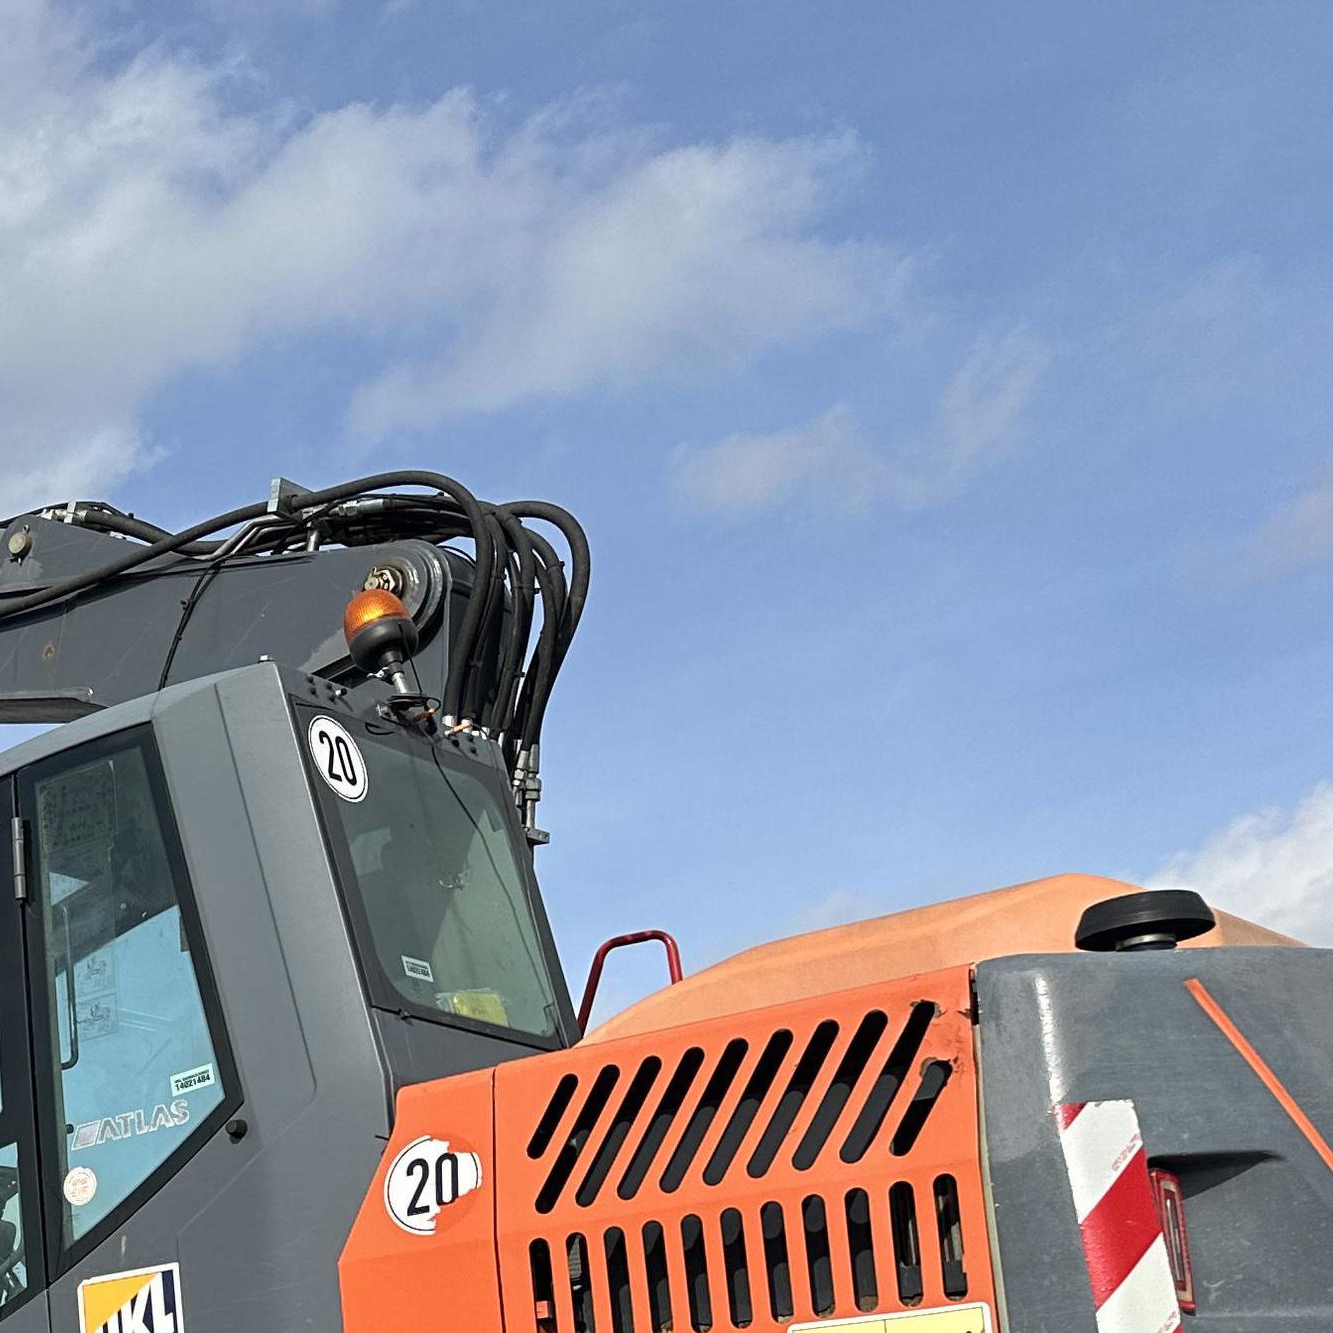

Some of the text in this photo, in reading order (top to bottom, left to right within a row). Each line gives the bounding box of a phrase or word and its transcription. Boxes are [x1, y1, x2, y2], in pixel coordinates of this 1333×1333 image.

[319, 730, 357, 787] 20
[96, 1098, 190, 1145] ATLAS
[406, 1152, 459, 1216] 20
